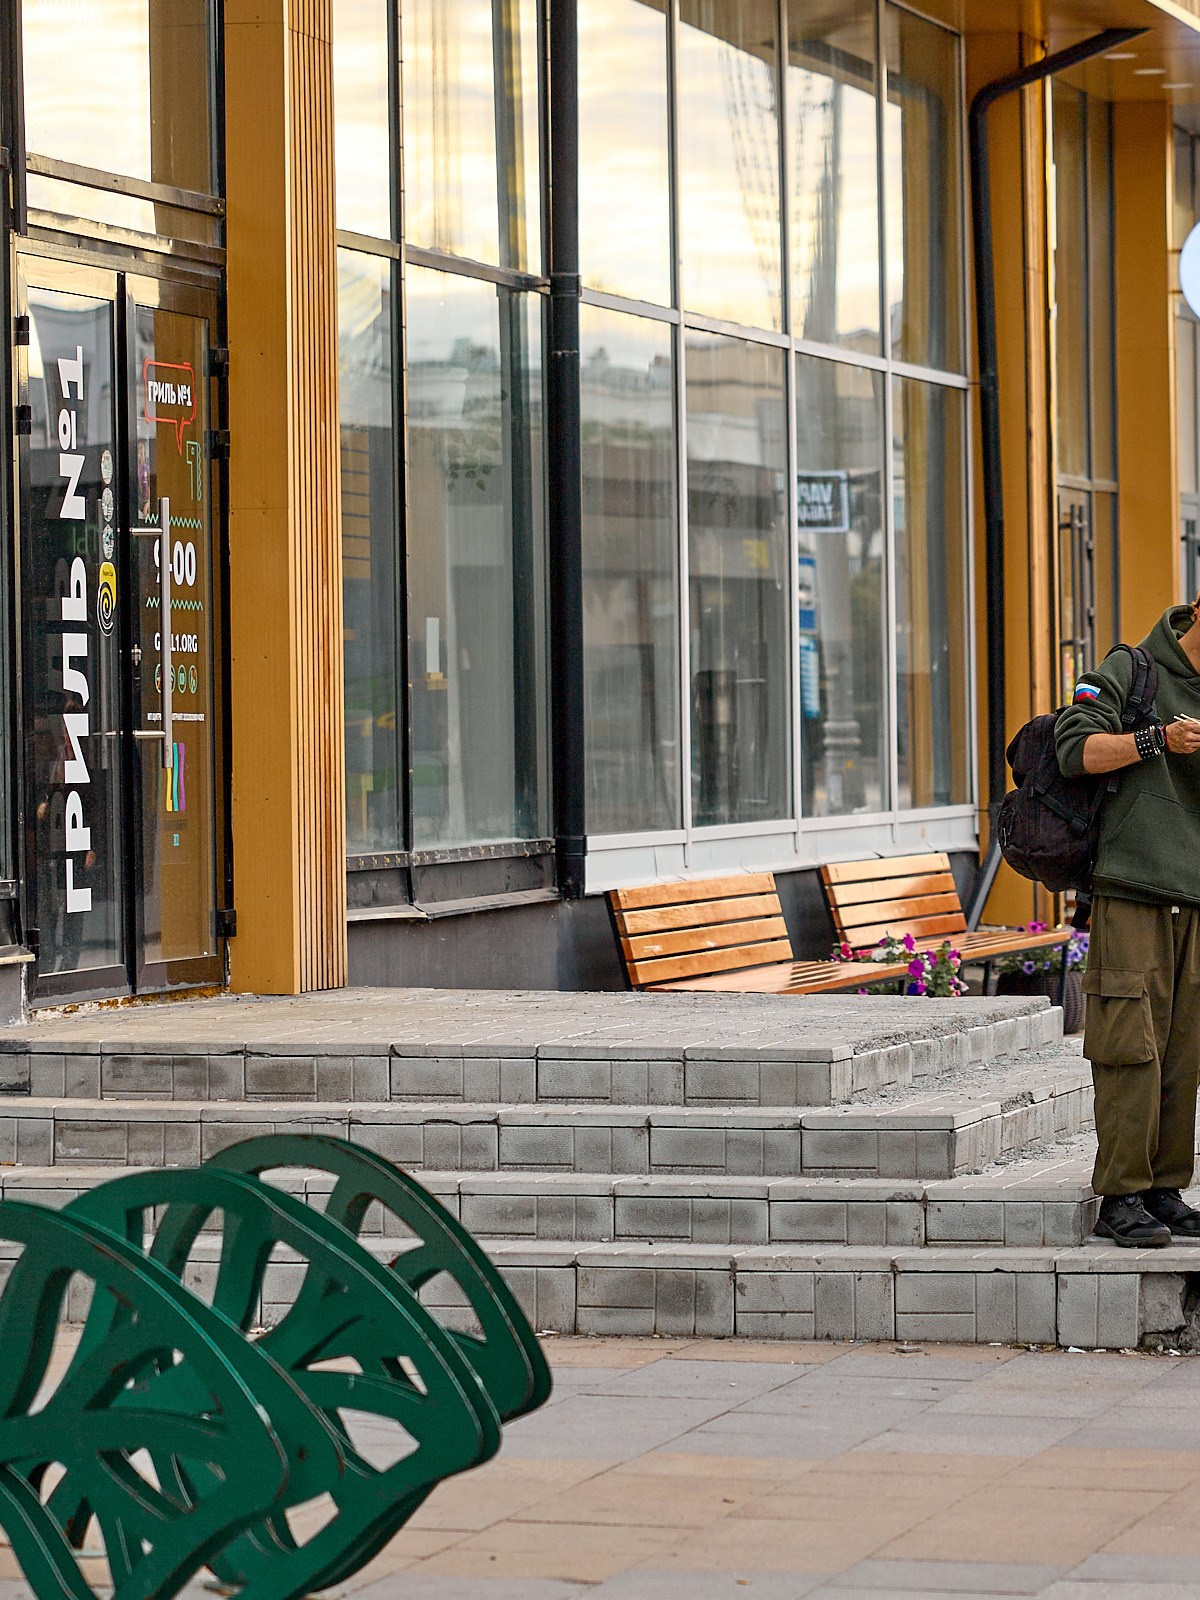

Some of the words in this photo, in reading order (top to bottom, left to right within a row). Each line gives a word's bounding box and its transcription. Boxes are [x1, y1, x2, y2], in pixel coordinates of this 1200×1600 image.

[57, 345, 86, 520] №1
[147, 380, 176, 405] ГРИЛЬ
[177, 384, 193, 407] №1
[61, 556, 92, 913] ГРИЛЬ
